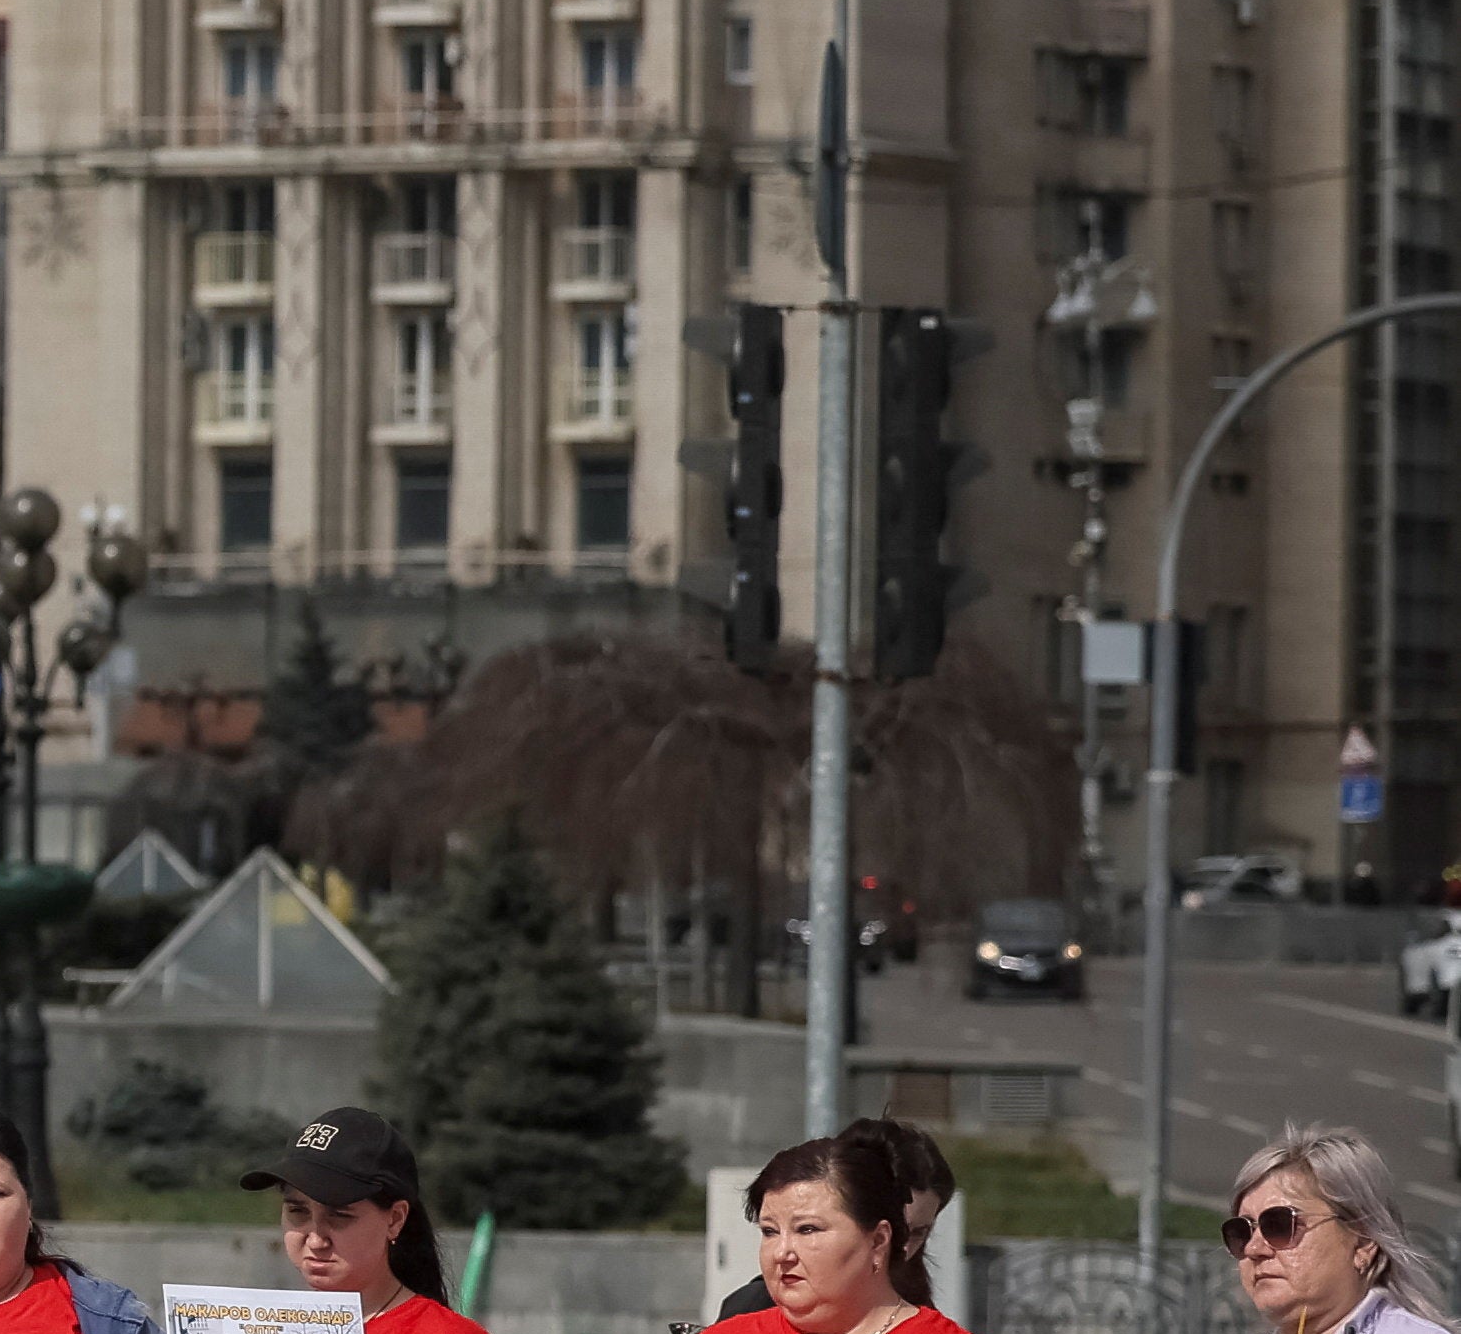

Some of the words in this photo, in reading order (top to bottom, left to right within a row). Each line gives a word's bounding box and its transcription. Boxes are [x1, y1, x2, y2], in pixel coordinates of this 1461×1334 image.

[296, 1123, 339, 1151] 23
[173, 1303, 252, 1321] МАКАРОВ
[254, 1307, 354, 1326] ОЛЕКСАНДР
